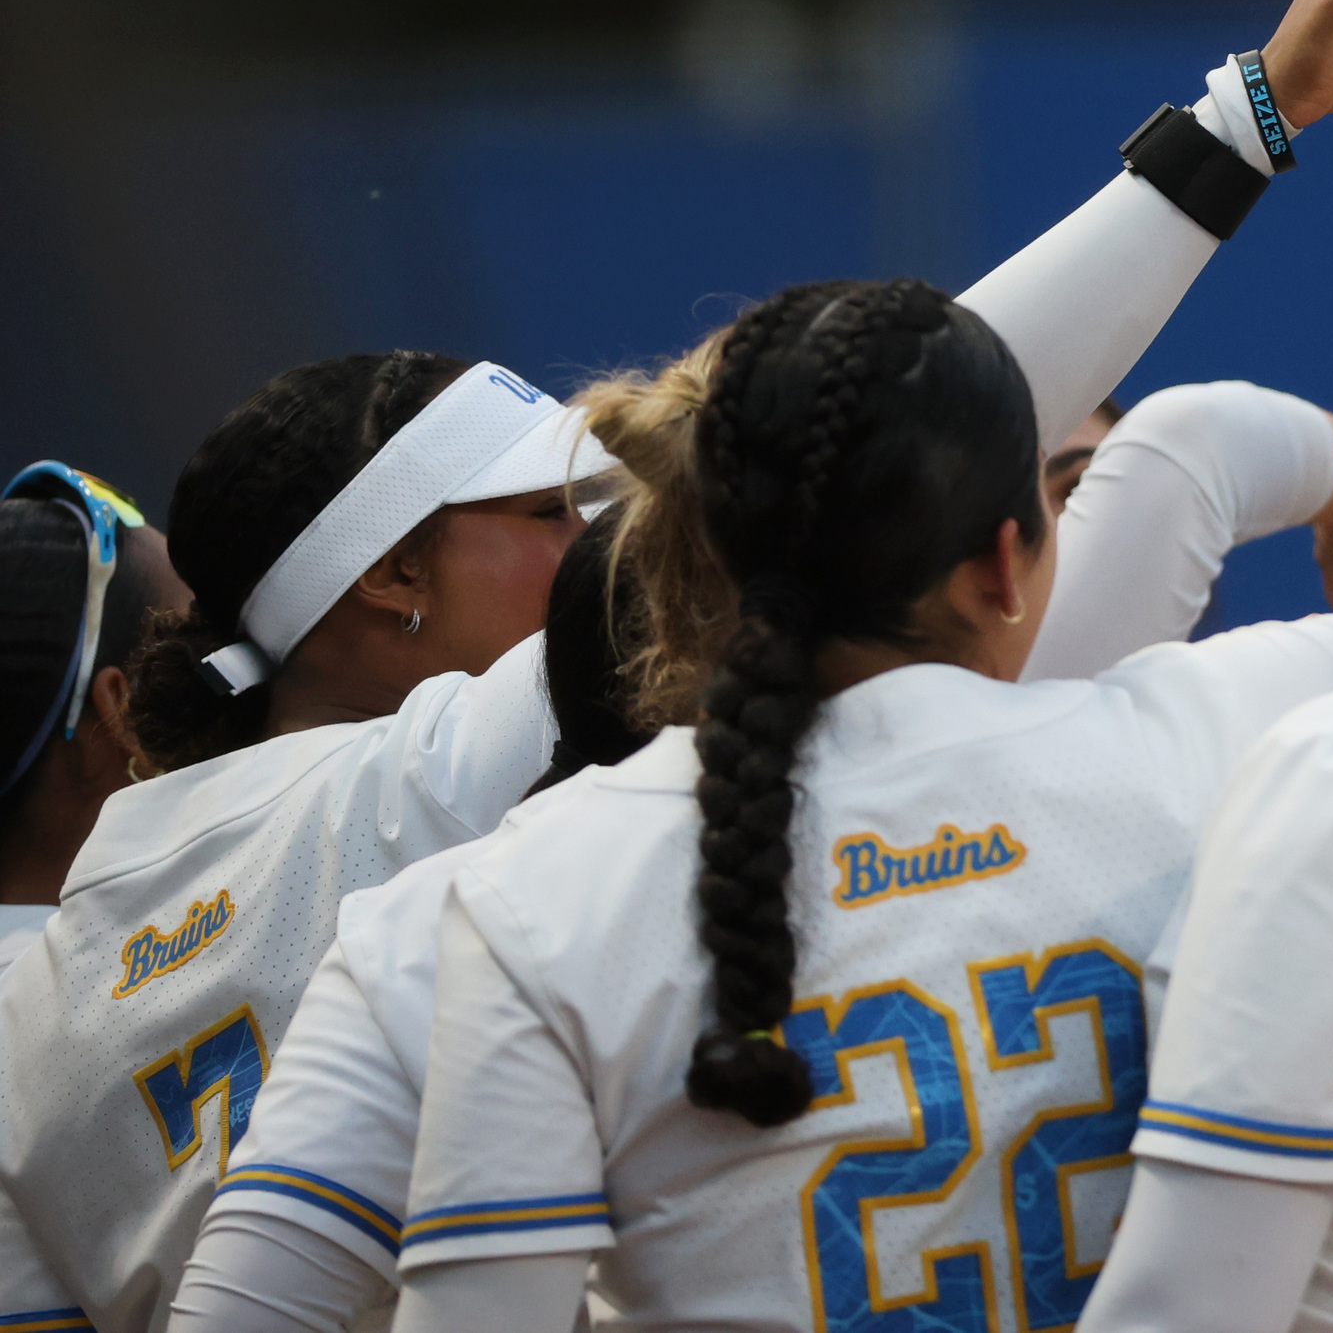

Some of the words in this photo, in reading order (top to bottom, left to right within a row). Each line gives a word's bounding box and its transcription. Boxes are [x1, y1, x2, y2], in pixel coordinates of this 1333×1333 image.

[1242, 64, 1262, 83] IT
[1249, 85, 1287, 155] SEIZE
[836, 827, 1024, 907] Bruins
[116, 893, 234, 995] Bruins
[133, 1001, 270, 1185] 7
[768, 937, 1148, 1333] 22
